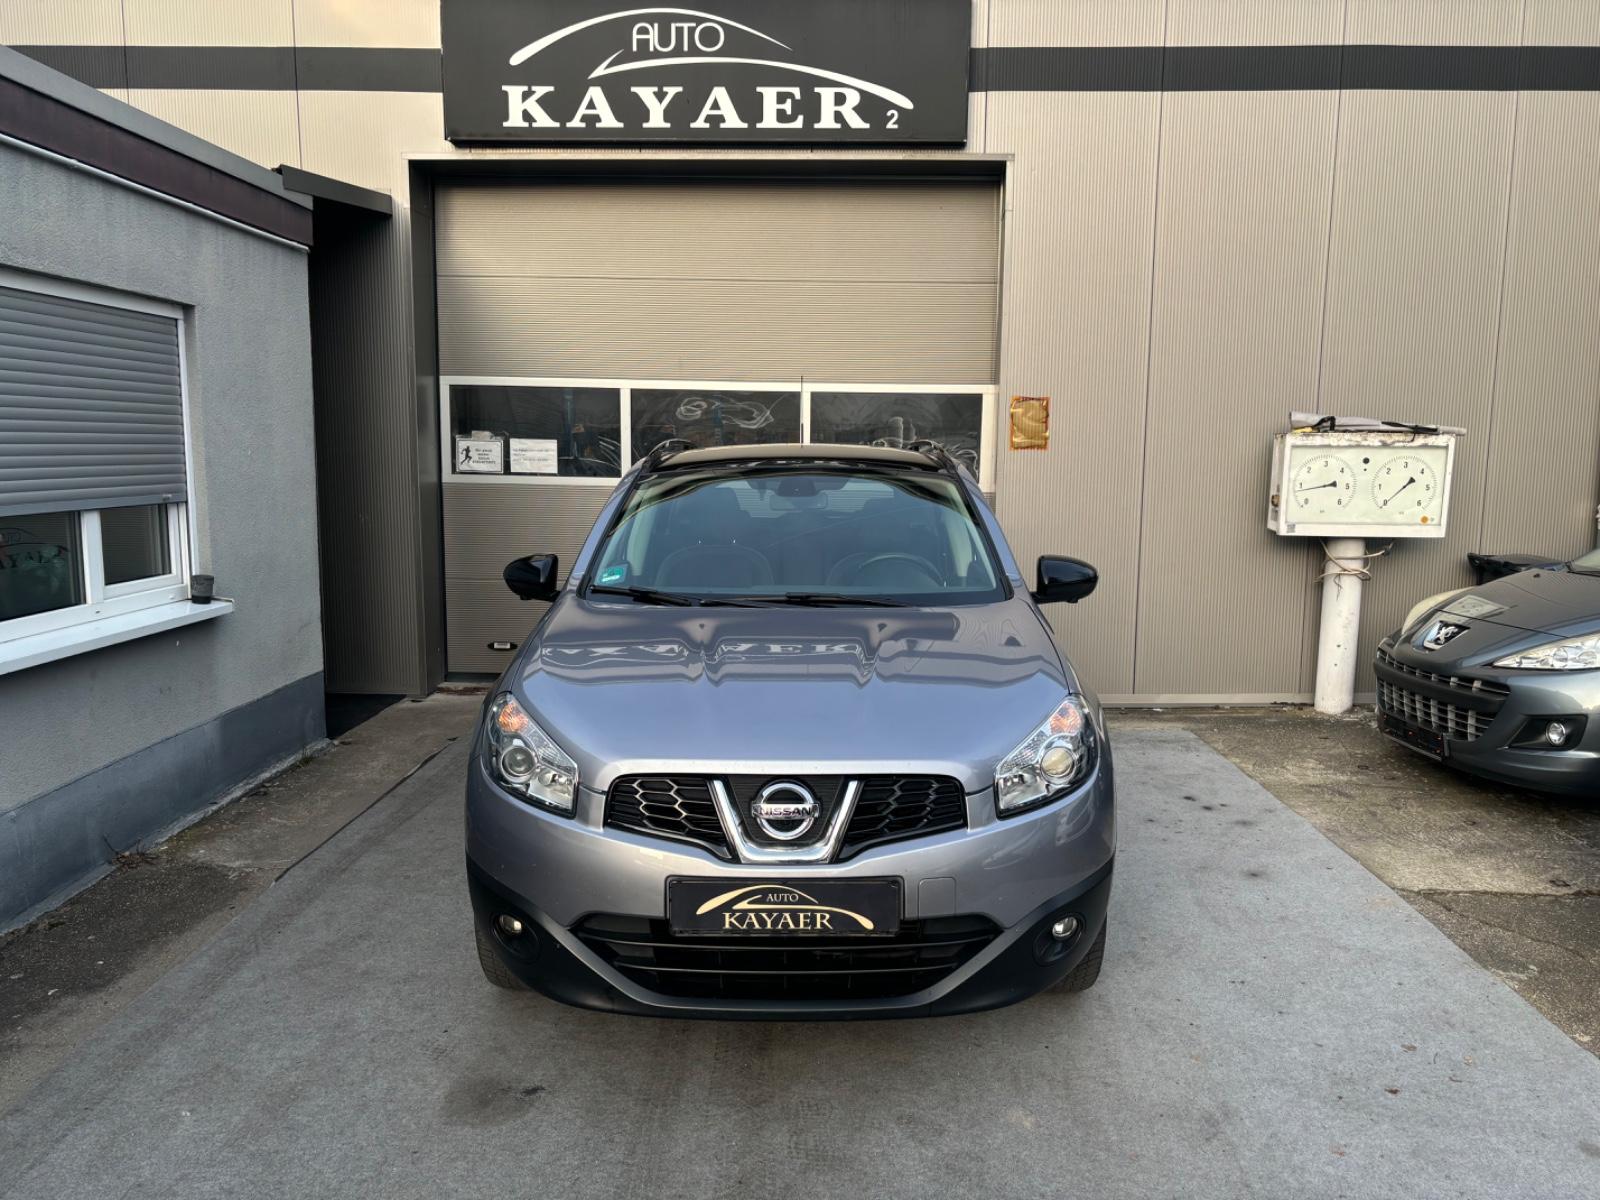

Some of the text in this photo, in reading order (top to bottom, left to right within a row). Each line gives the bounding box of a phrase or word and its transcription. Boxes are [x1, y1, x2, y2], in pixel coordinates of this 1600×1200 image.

[631, 22, 725, 52] AUTO
[501, 85, 899, 130] KAYAER 2
[759, 807, 811, 817] NISSAN
[766, 893, 799, 903] AUTO
[722, 912, 833, 930] KAYAER
